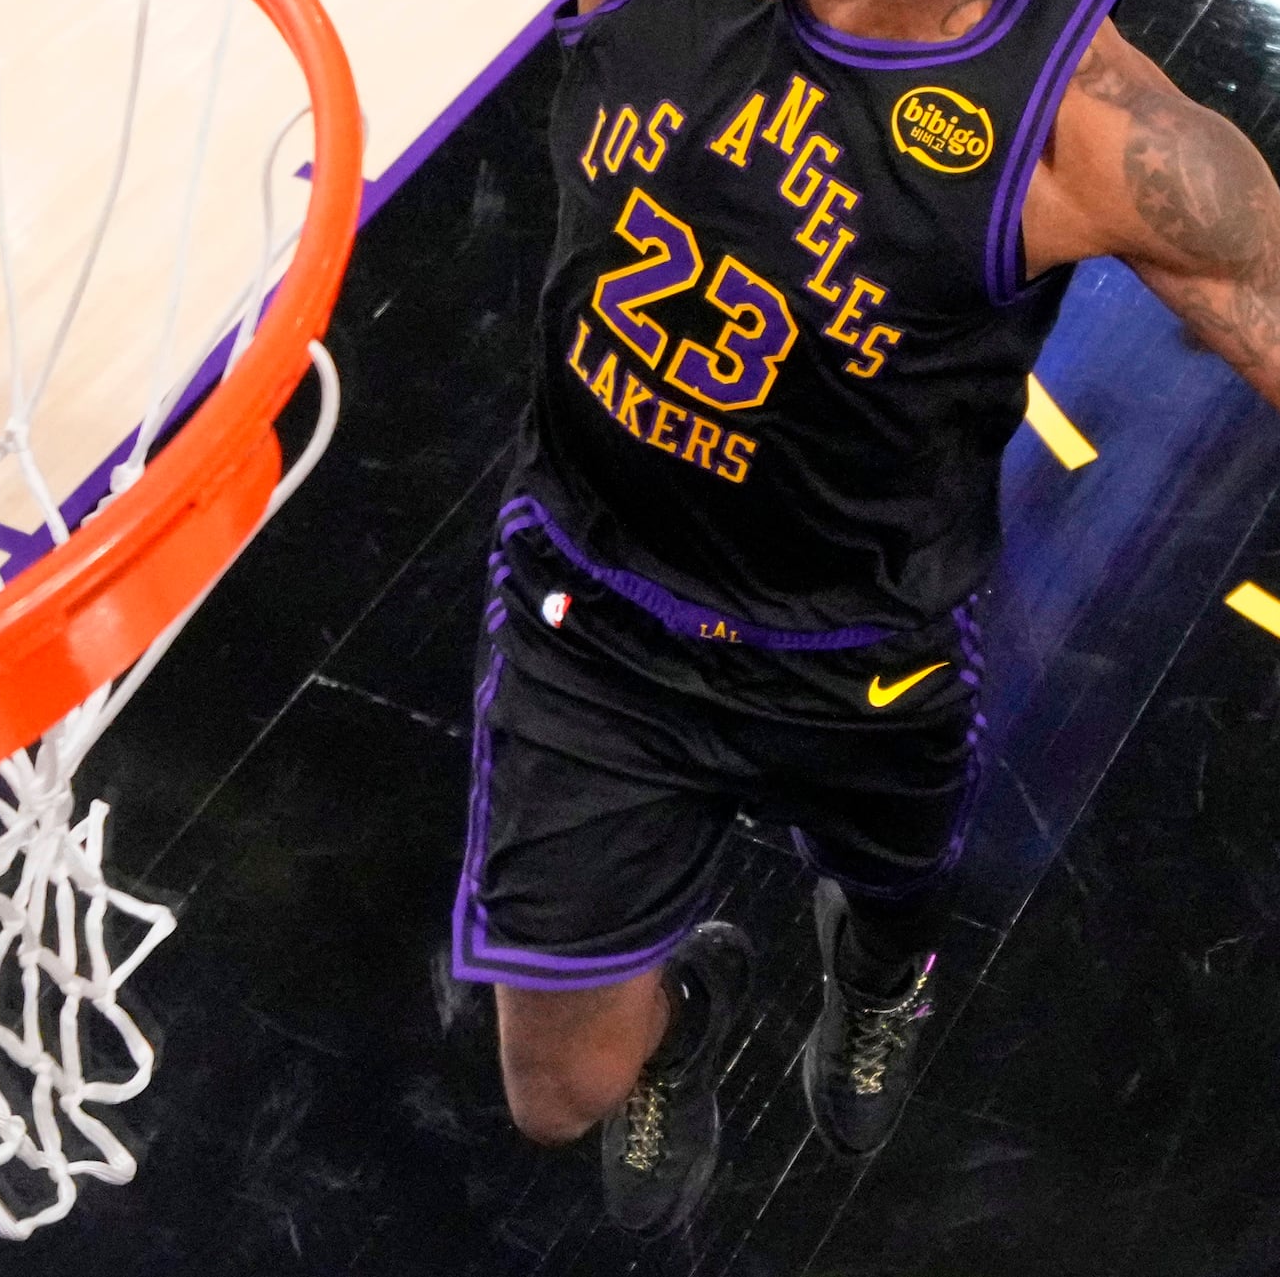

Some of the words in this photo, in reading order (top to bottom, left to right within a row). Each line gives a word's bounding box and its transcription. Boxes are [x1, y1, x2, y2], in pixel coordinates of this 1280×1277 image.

[903, 96, 986, 157] bibigo
[580, 100, 685, 181] LOS
[711, 74, 900, 380] ANGELES
[592, 187, 798, 413] 23
[567, 319, 759, 484] LAKERS
